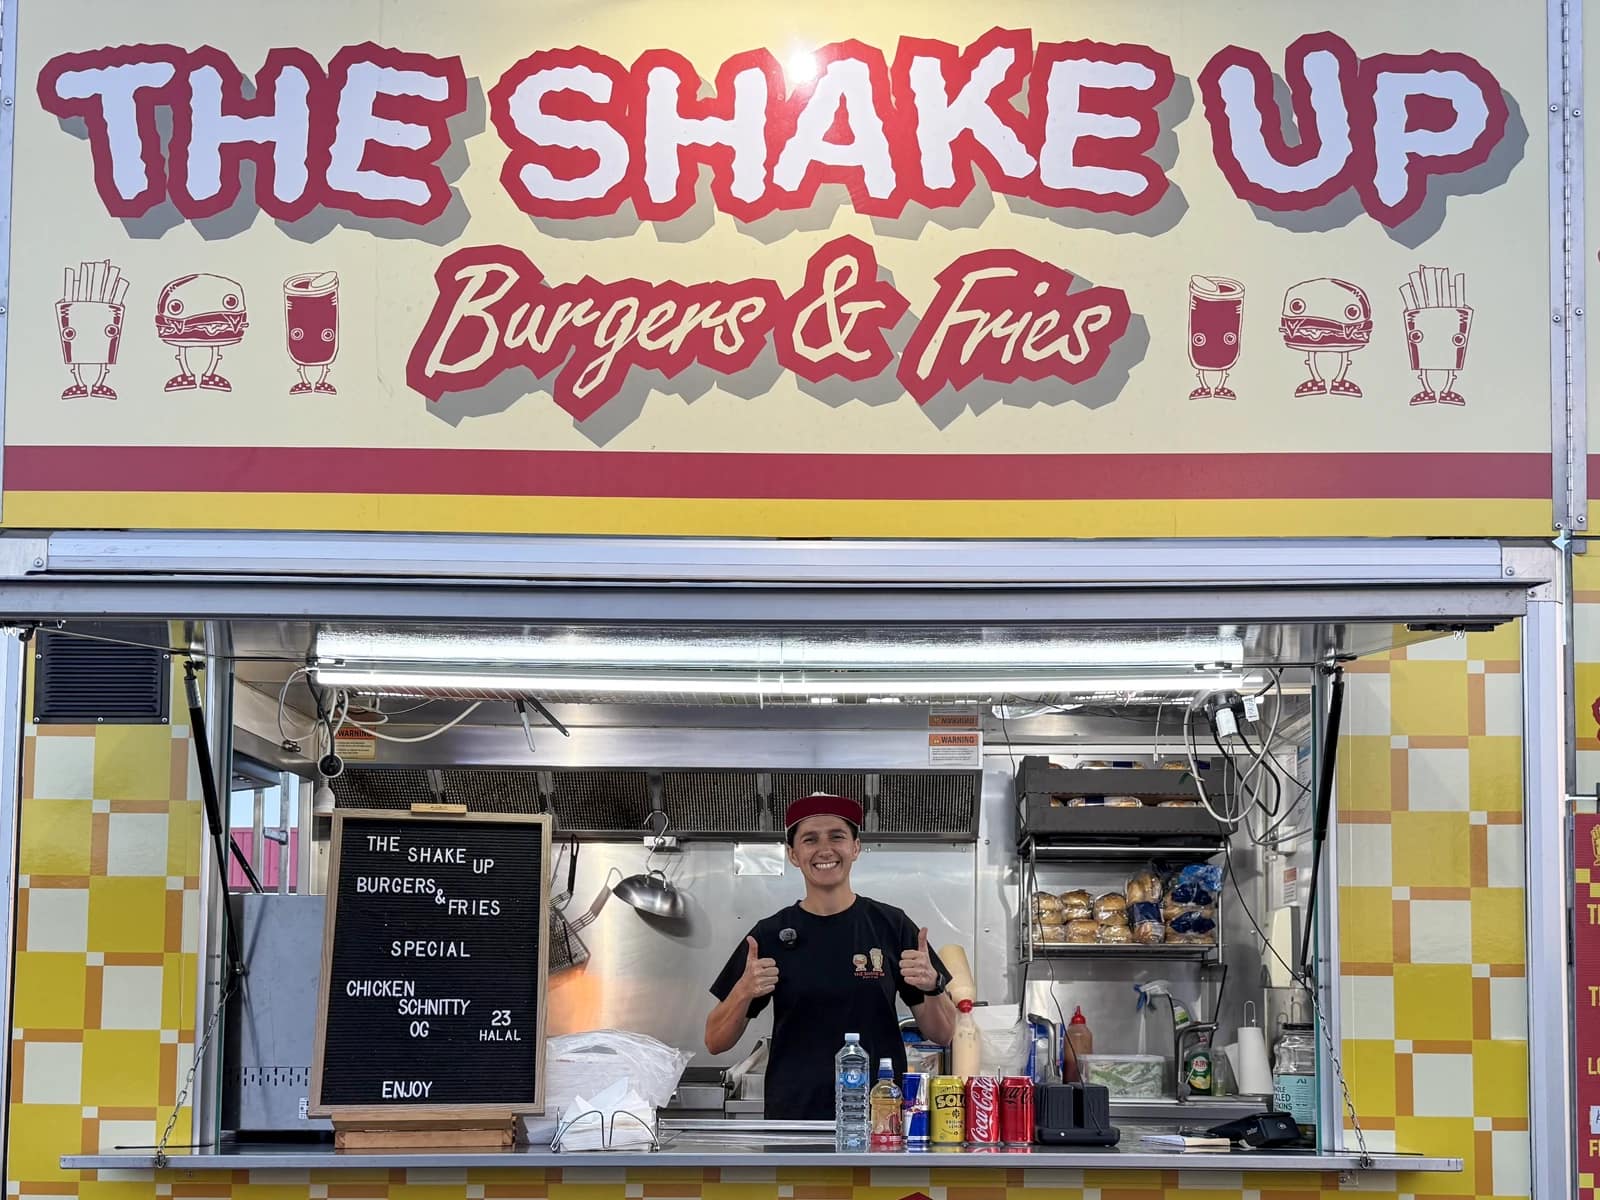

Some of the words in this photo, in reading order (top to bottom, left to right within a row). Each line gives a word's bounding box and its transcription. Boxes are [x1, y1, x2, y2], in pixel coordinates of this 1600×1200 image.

[55, 59, 450, 207] THE
[508, 46, 1157, 205] SHAKE
[1217, 49, 1490, 208] UP
[425, 263, 766, 398] Burgers
[791, 253, 887, 363] &
[916, 266, 1112, 380] Fries
[366, 836, 401, 852] THE
[407, 847, 467, 864] SHAKE
[472, 858, 495, 875] UP
[356, 876, 436, 894] BURGERS
[435, 888, 446, 904] &
[448, 900, 501, 916] FRIES
[391, 941, 471, 958] SPECIAL
[346, 980, 415, 997] CHICKEN
[398, 999, 471, 1016] SCHNITTY
[409, 1020, 430, 1038] OG
[491, 1009, 512, 1027] 23
[479, 1029, 521, 1042] HALAL
[381, 1081, 433, 1099] ENJOY
